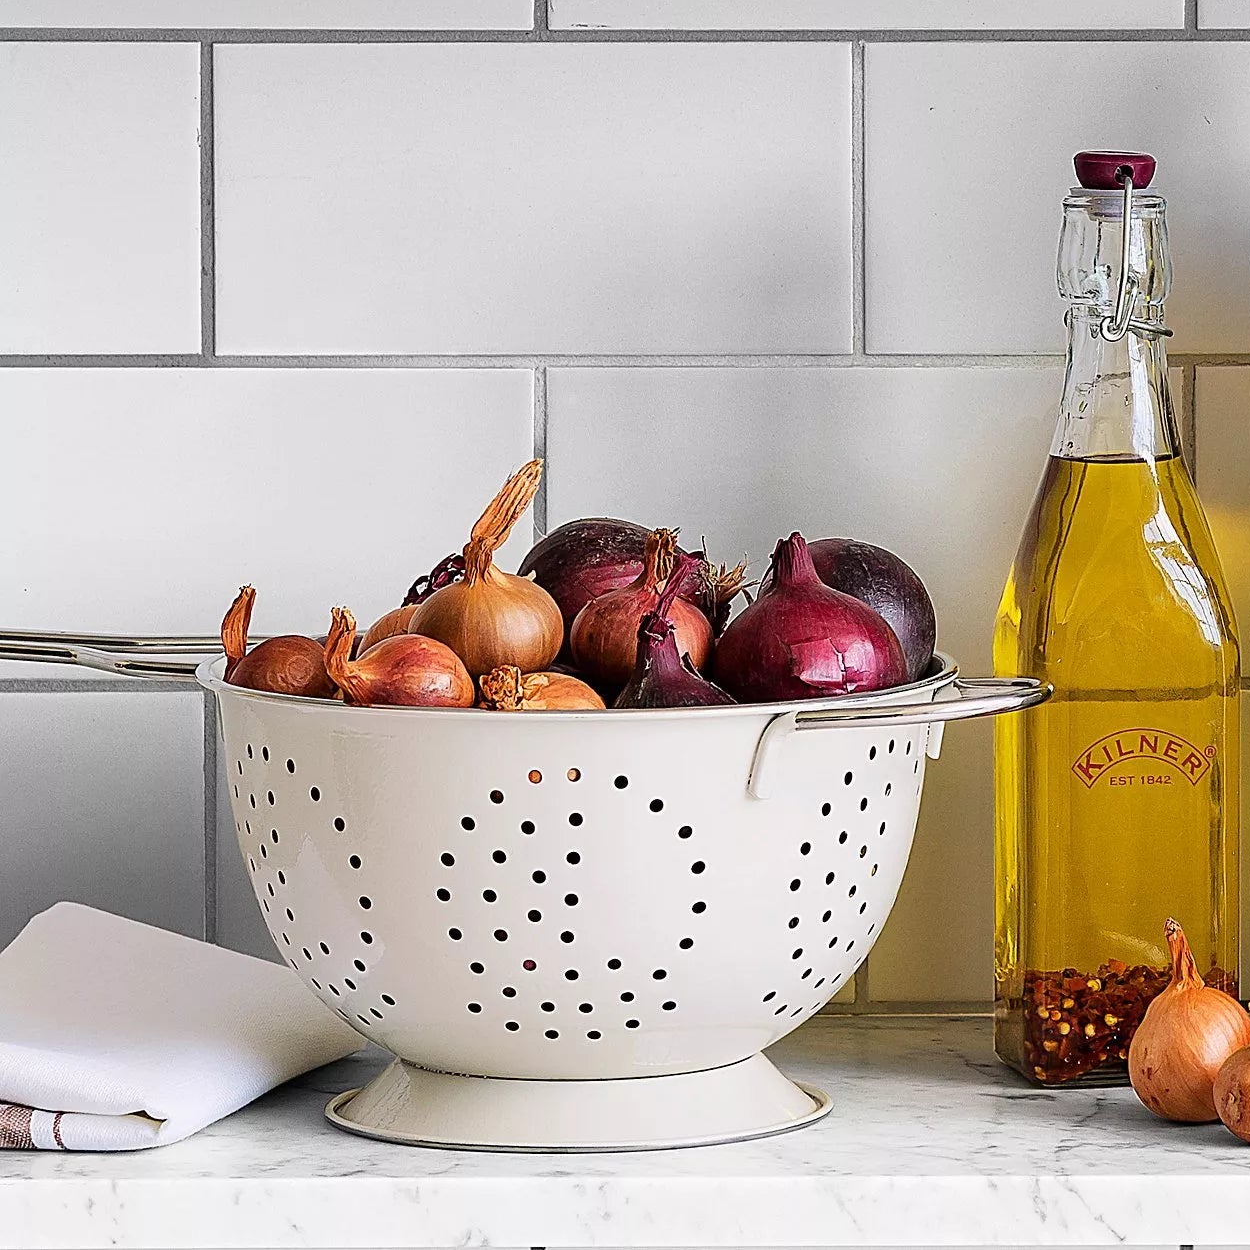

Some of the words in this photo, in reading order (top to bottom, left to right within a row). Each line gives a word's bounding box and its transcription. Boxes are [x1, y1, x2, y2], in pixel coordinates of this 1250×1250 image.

[1077, 734, 1203, 780] KILNER
[1109, 776, 1135, 786] EST
[1140, 775, 1171, 785] 1842
